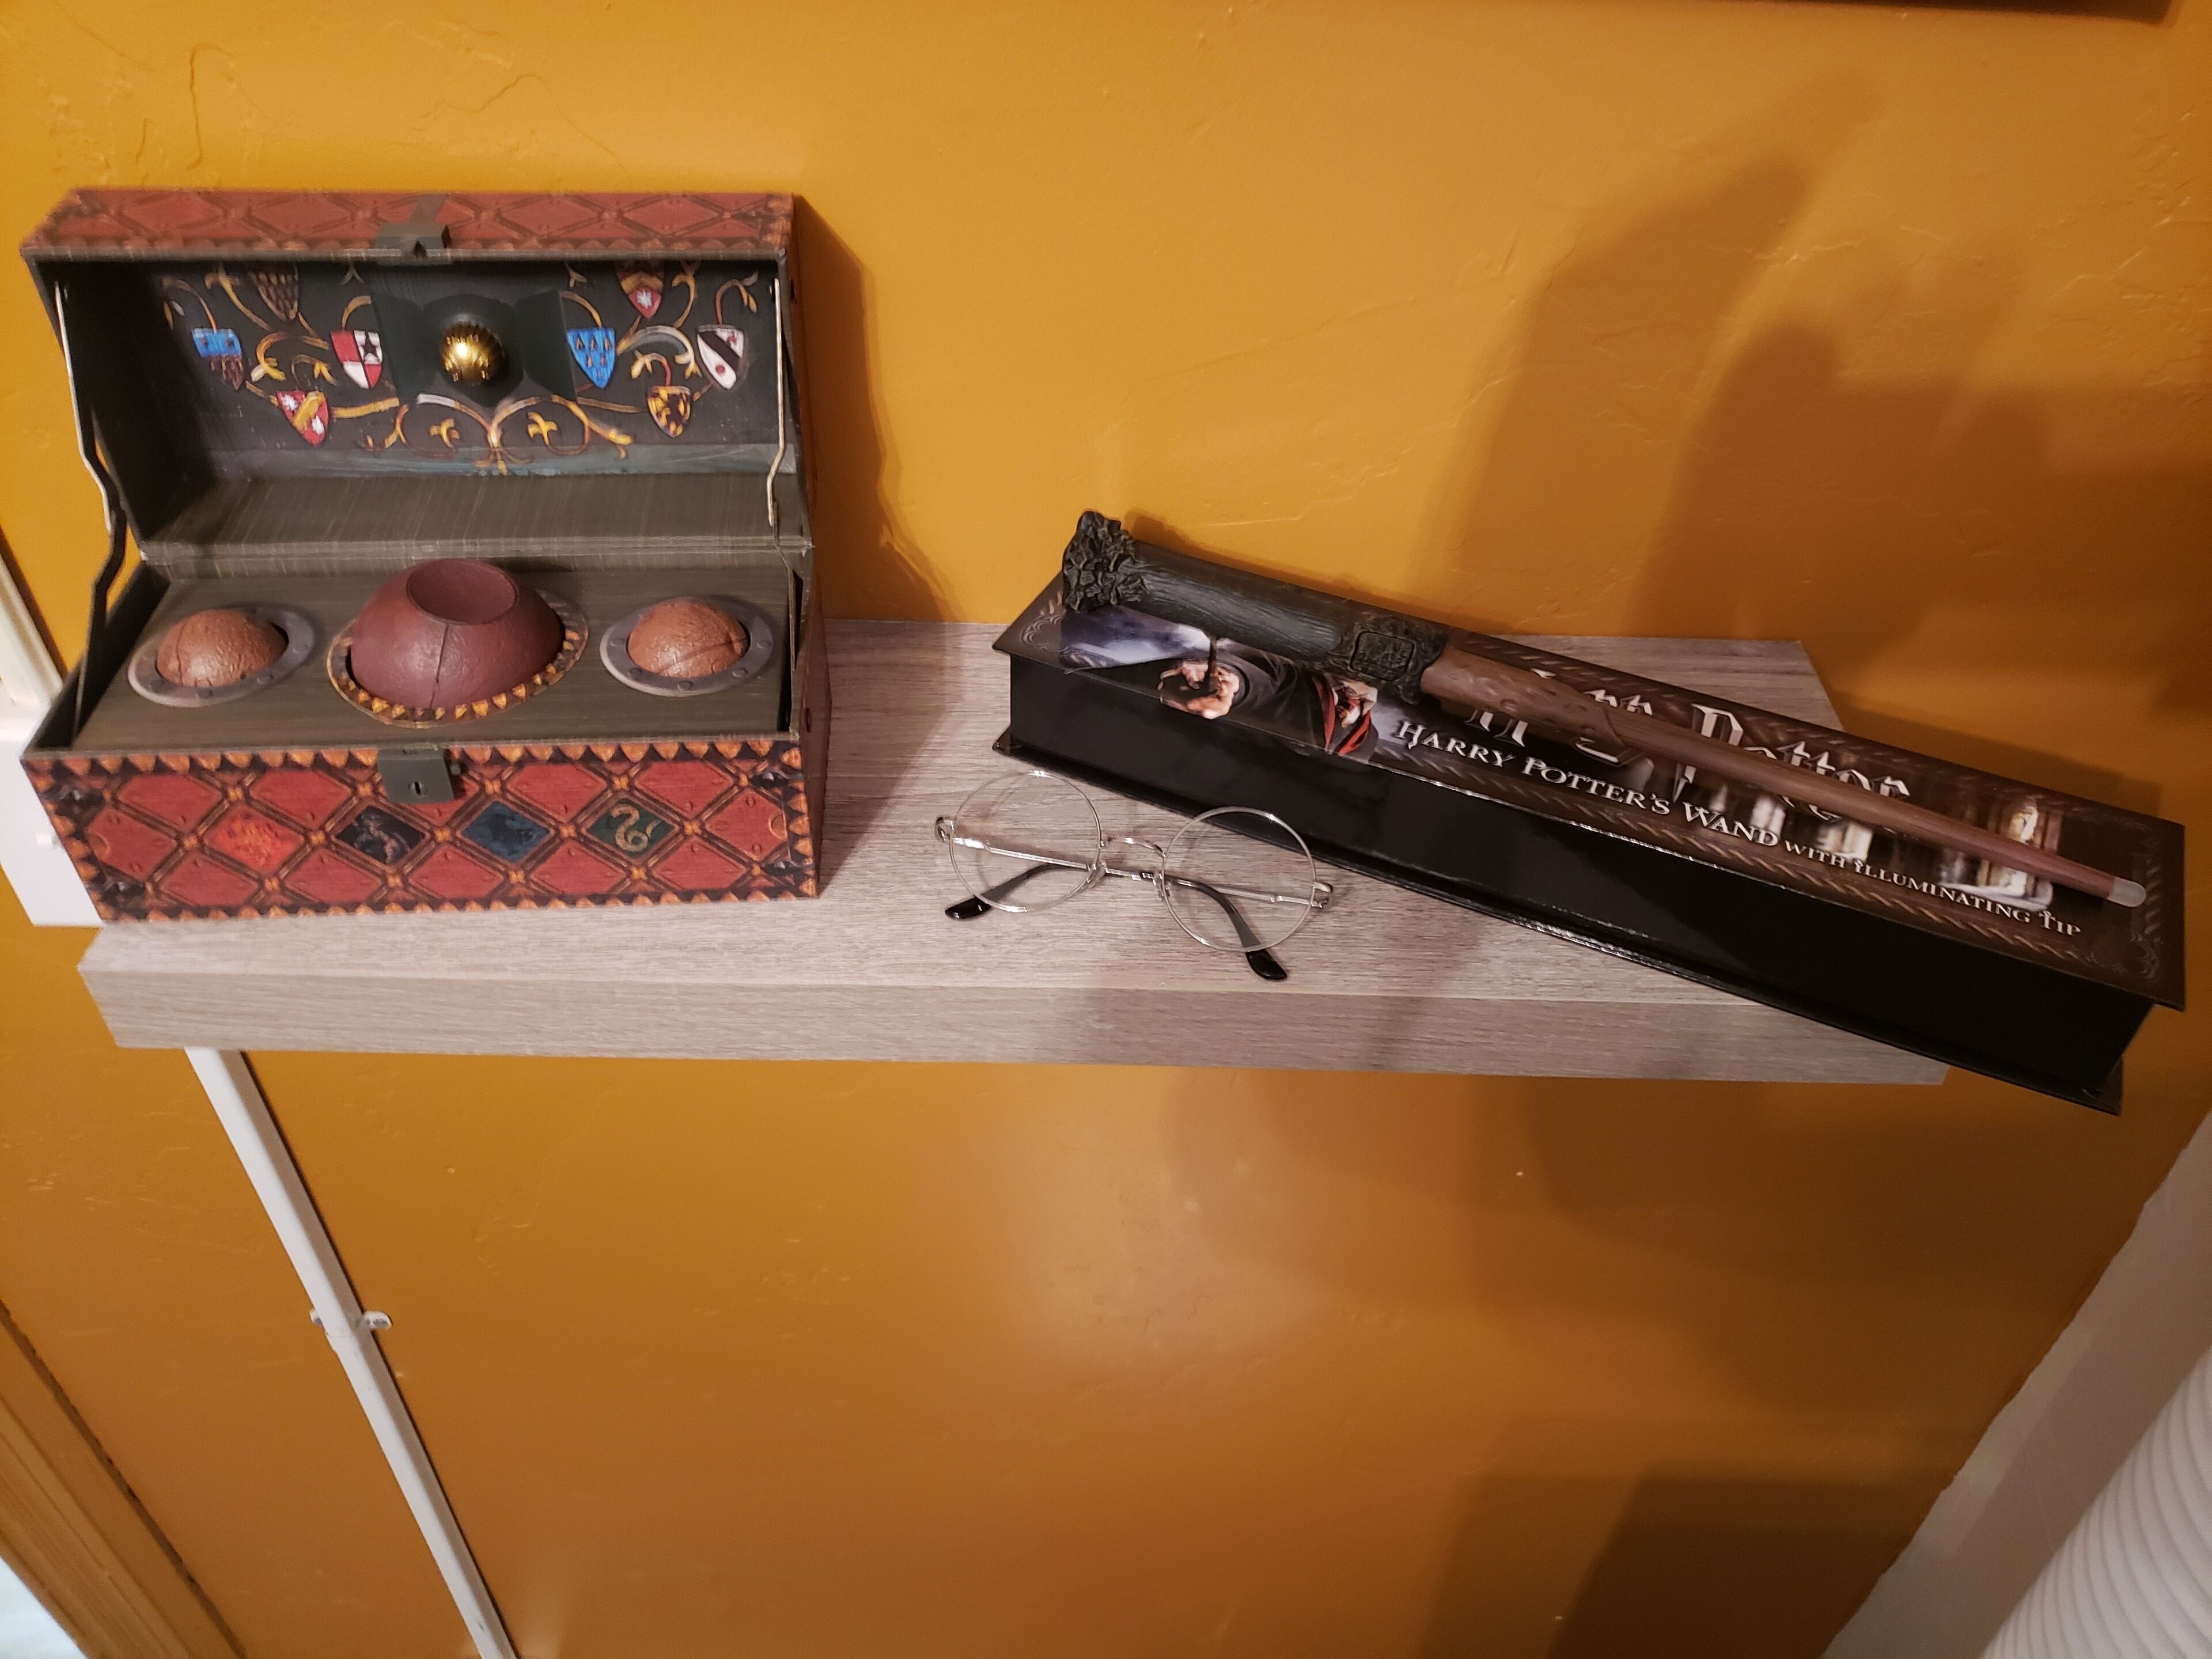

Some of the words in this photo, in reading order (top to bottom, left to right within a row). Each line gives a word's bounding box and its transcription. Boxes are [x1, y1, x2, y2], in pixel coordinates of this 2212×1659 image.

[1394, 719, 1516, 768] HARRY
[1520, 756, 1671, 816] POTTER'S
[1682, 801, 1779, 847] WAND
[1785, 840, 1846, 869] WITH
[1853, 859, 2031, 923] ILLUMINATING
[2037, 911, 2081, 937] TIP
